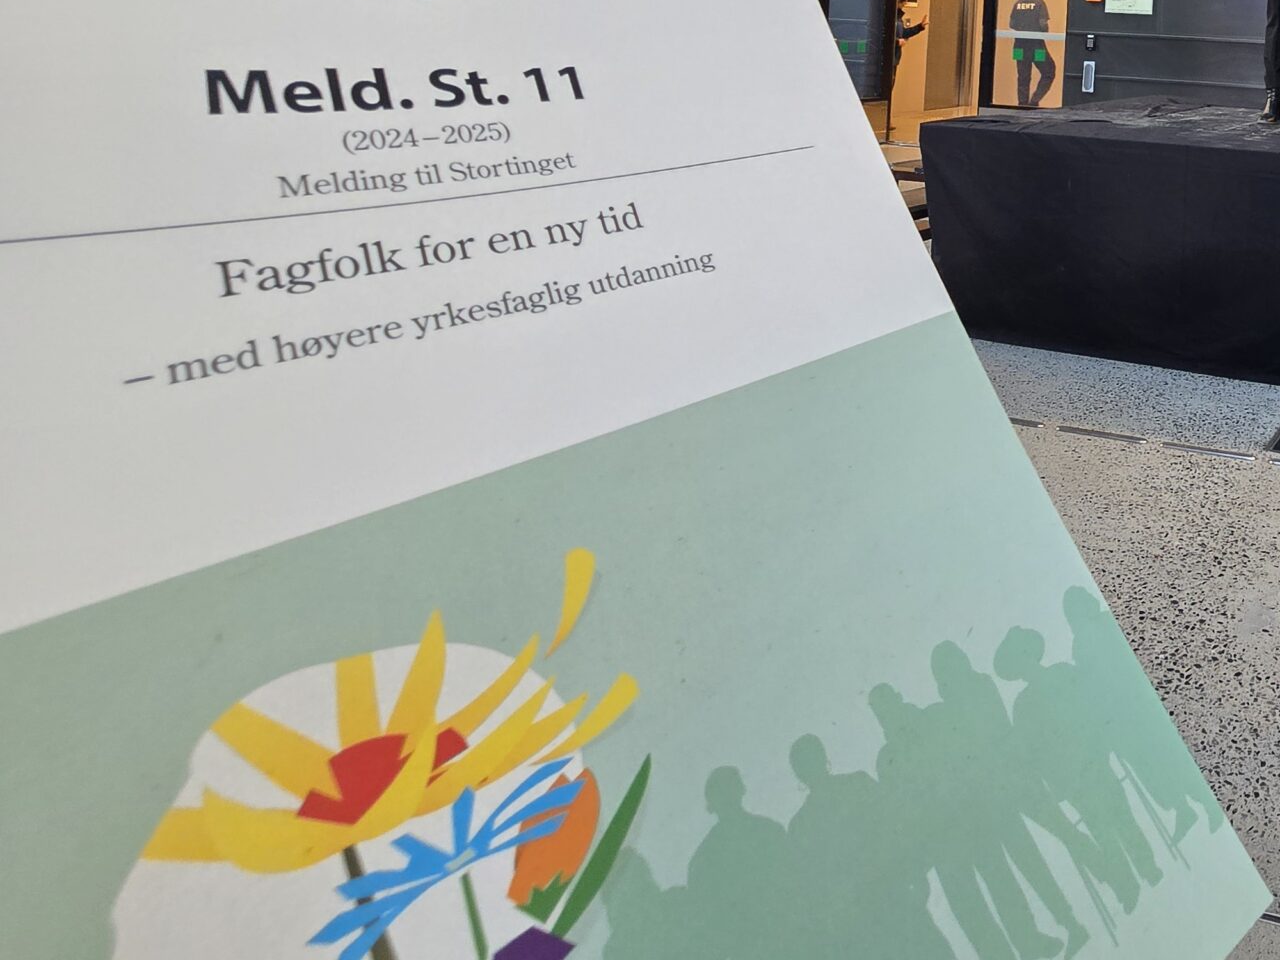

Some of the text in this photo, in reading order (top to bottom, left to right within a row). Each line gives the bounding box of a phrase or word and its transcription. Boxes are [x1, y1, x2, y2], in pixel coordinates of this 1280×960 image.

[205, 66, 586, 115] Meld. St. 11
[275, 151, 577, 198] Melding til Stortinget
[214, 202, 645, 298] Fagfolk for en ny tid
[167, 339, 264, 386] med
[273, 317, 404, 364] høyere
[410, 279, 583, 339] yrkesfaglig
[588, 249, 717, 297] utdanning
